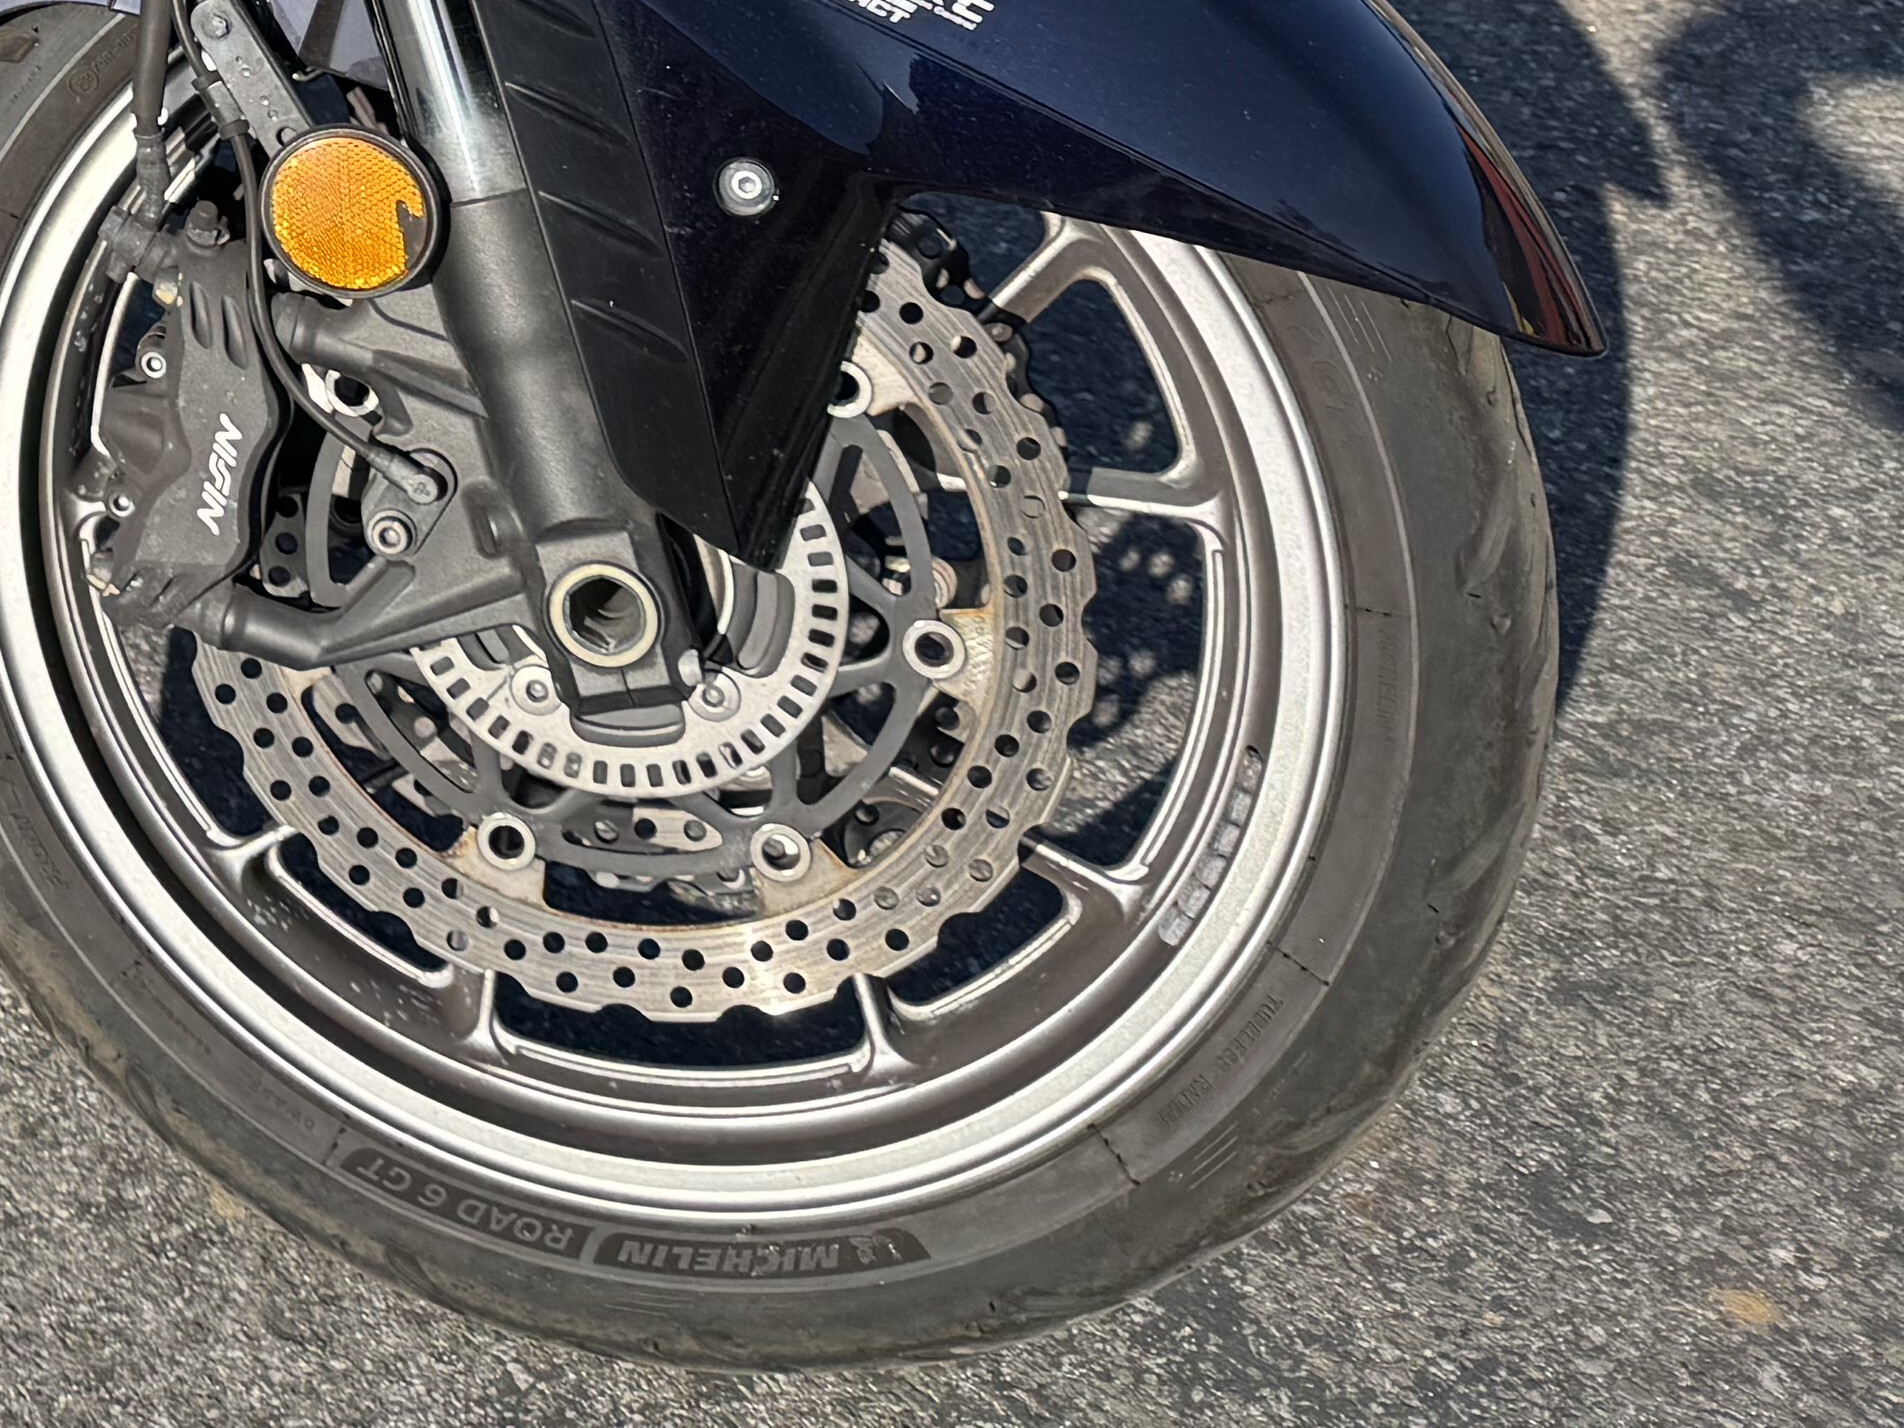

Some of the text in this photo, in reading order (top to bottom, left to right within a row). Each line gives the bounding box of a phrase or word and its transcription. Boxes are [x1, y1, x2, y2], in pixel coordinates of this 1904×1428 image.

[355, 1156, 840, 1275] MICHELIN ROAD 6 GT
